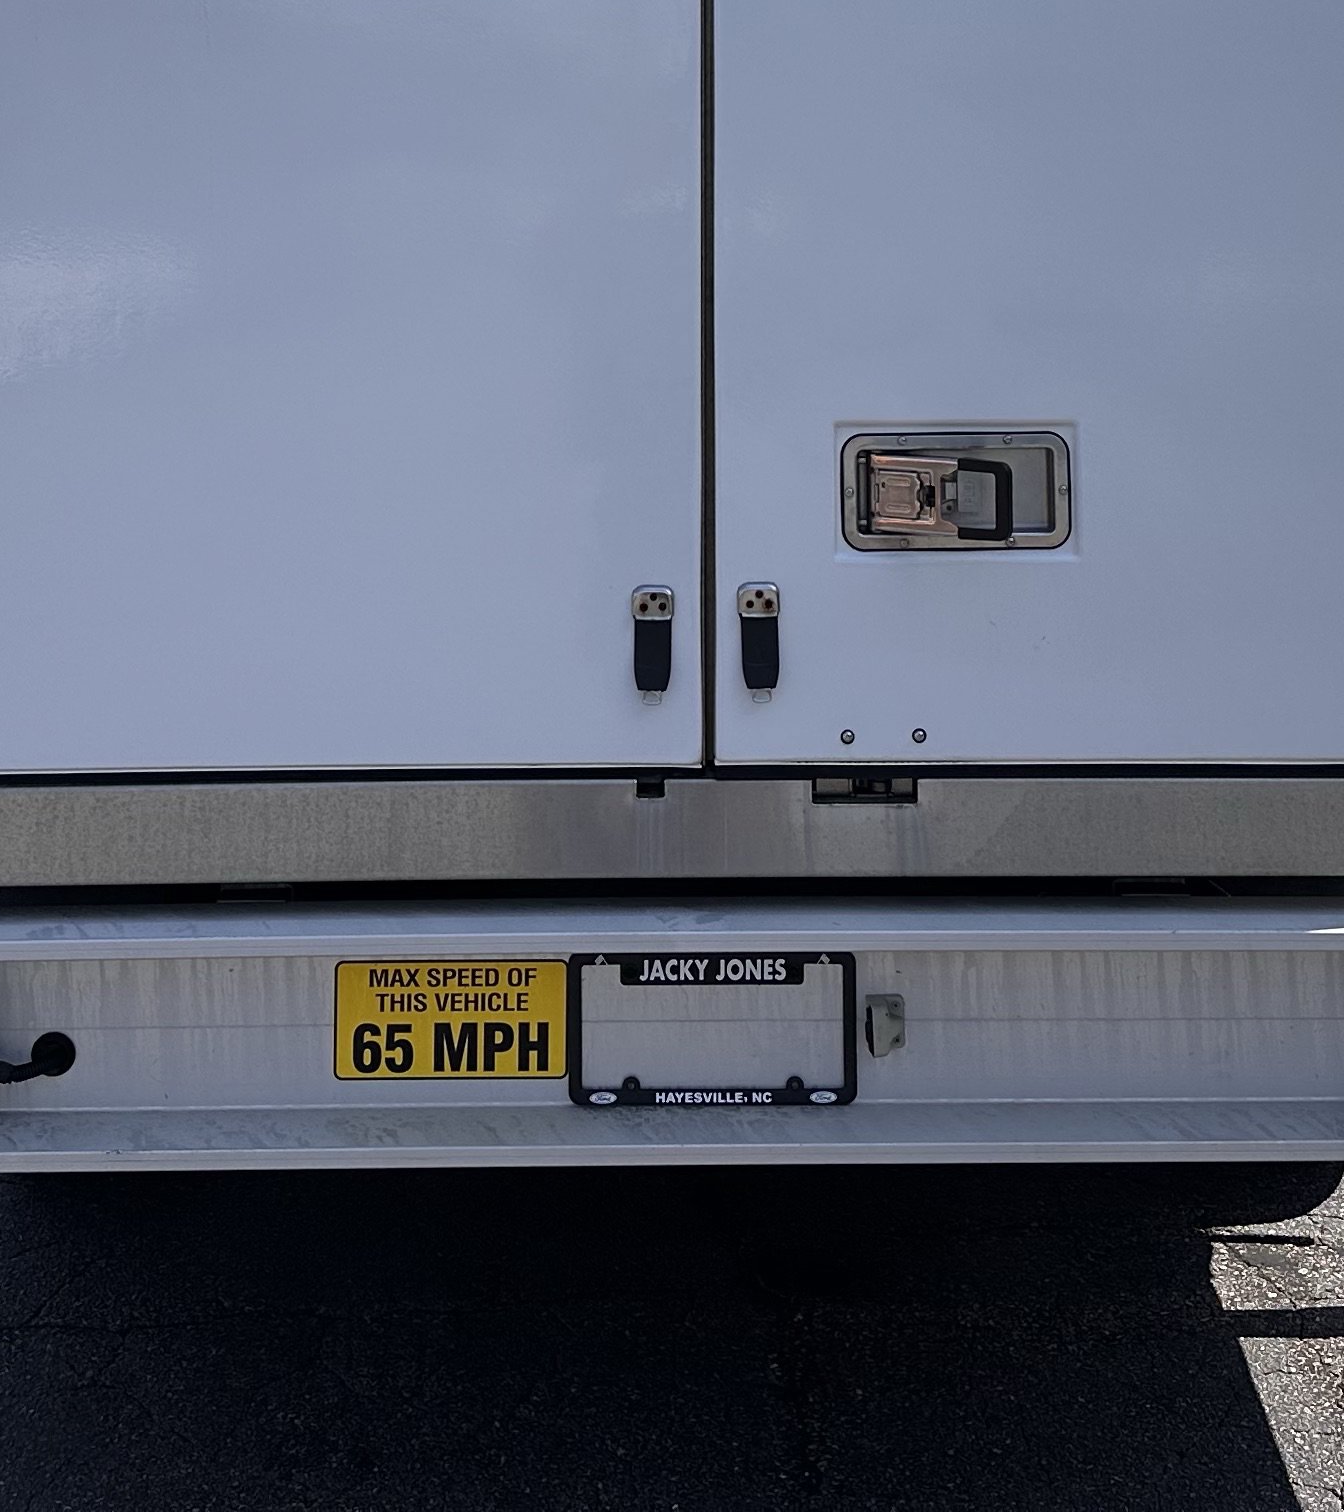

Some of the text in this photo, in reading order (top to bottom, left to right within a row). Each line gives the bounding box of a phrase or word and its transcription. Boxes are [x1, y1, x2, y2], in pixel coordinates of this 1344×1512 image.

[369, 967, 537, 988] MAX SPEED OF
[639, 958, 787, 982] JACKY JONES
[375, 992, 529, 1013] THIS VEHICLE
[352, 1021, 549, 1074] 65 MPH
[655, 1091, 773, 1103] HAYESVILLE, NC
